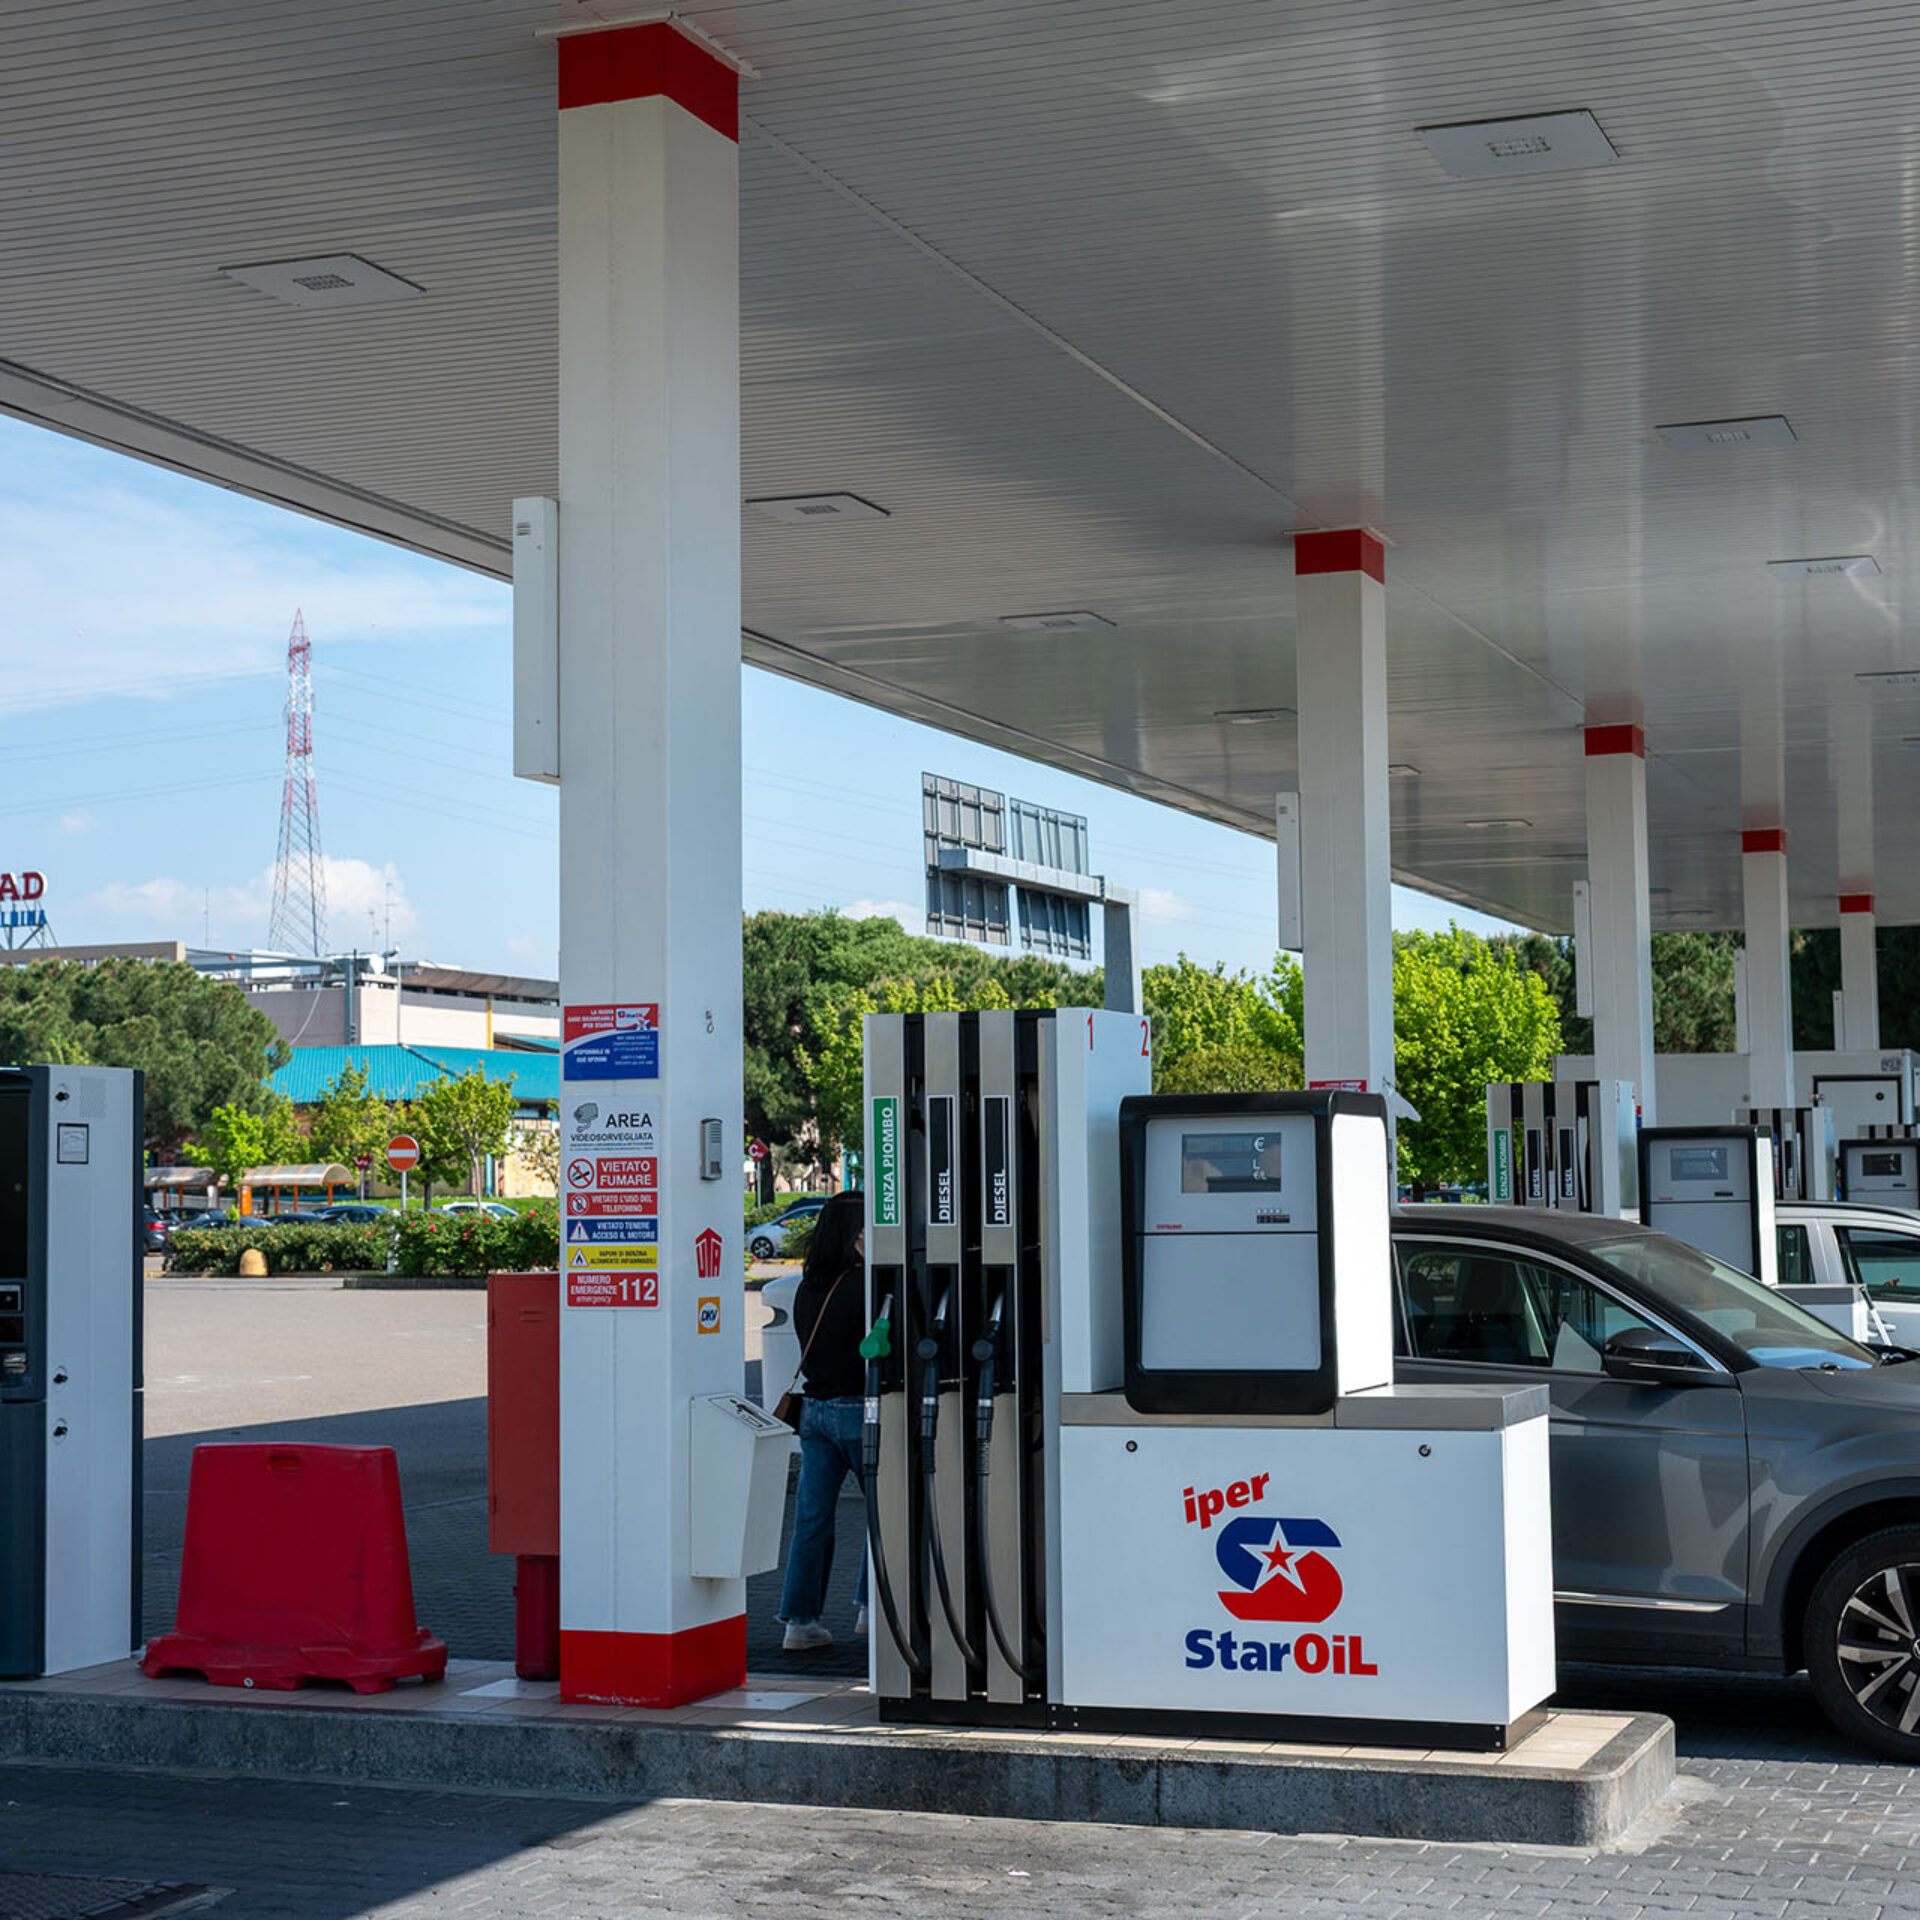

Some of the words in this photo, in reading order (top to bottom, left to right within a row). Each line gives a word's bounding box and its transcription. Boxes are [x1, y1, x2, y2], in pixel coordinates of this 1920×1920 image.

[1087, 1013, 1094, 1051] 1
[1140, 1020, 1149, 1057] 2
[605, 1112, 652, 1128] AREA
[570, 1132, 653, 1142] VIDEOSORVEGLIATA
[882, 1106, 895, 1167] PIOMBO
[600, 1160, 650, 1172] VIETATO
[600, 1174, 651, 1186] FUMARE
[591, 1195, 618, 1204] VIETATO
[883, 1172, 895, 1221] SENZA
[938, 1168, 951, 1220] DIESEL
[993, 1168, 1007, 1221] DIESEL
[602, 1204, 643, 1213] TELEFONINO
[596, 1221, 624, 1230] VIETATO
[625, 1221, 649, 1229] TENERE
[591, 1231, 618, 1240] ACCESO
[619, 1231, 626, 1239] IL
[627, 1231, 655, 1240] MOTORE
[577, 1275, 611, 1284] NUMERO
[570, 1285, 618, 1295] EMERGENZE
[619, 1278, 656, 1301] 112
[701, 1309, 718, 1322] DKV
[1183, 1472, 1270, 1530] iper
